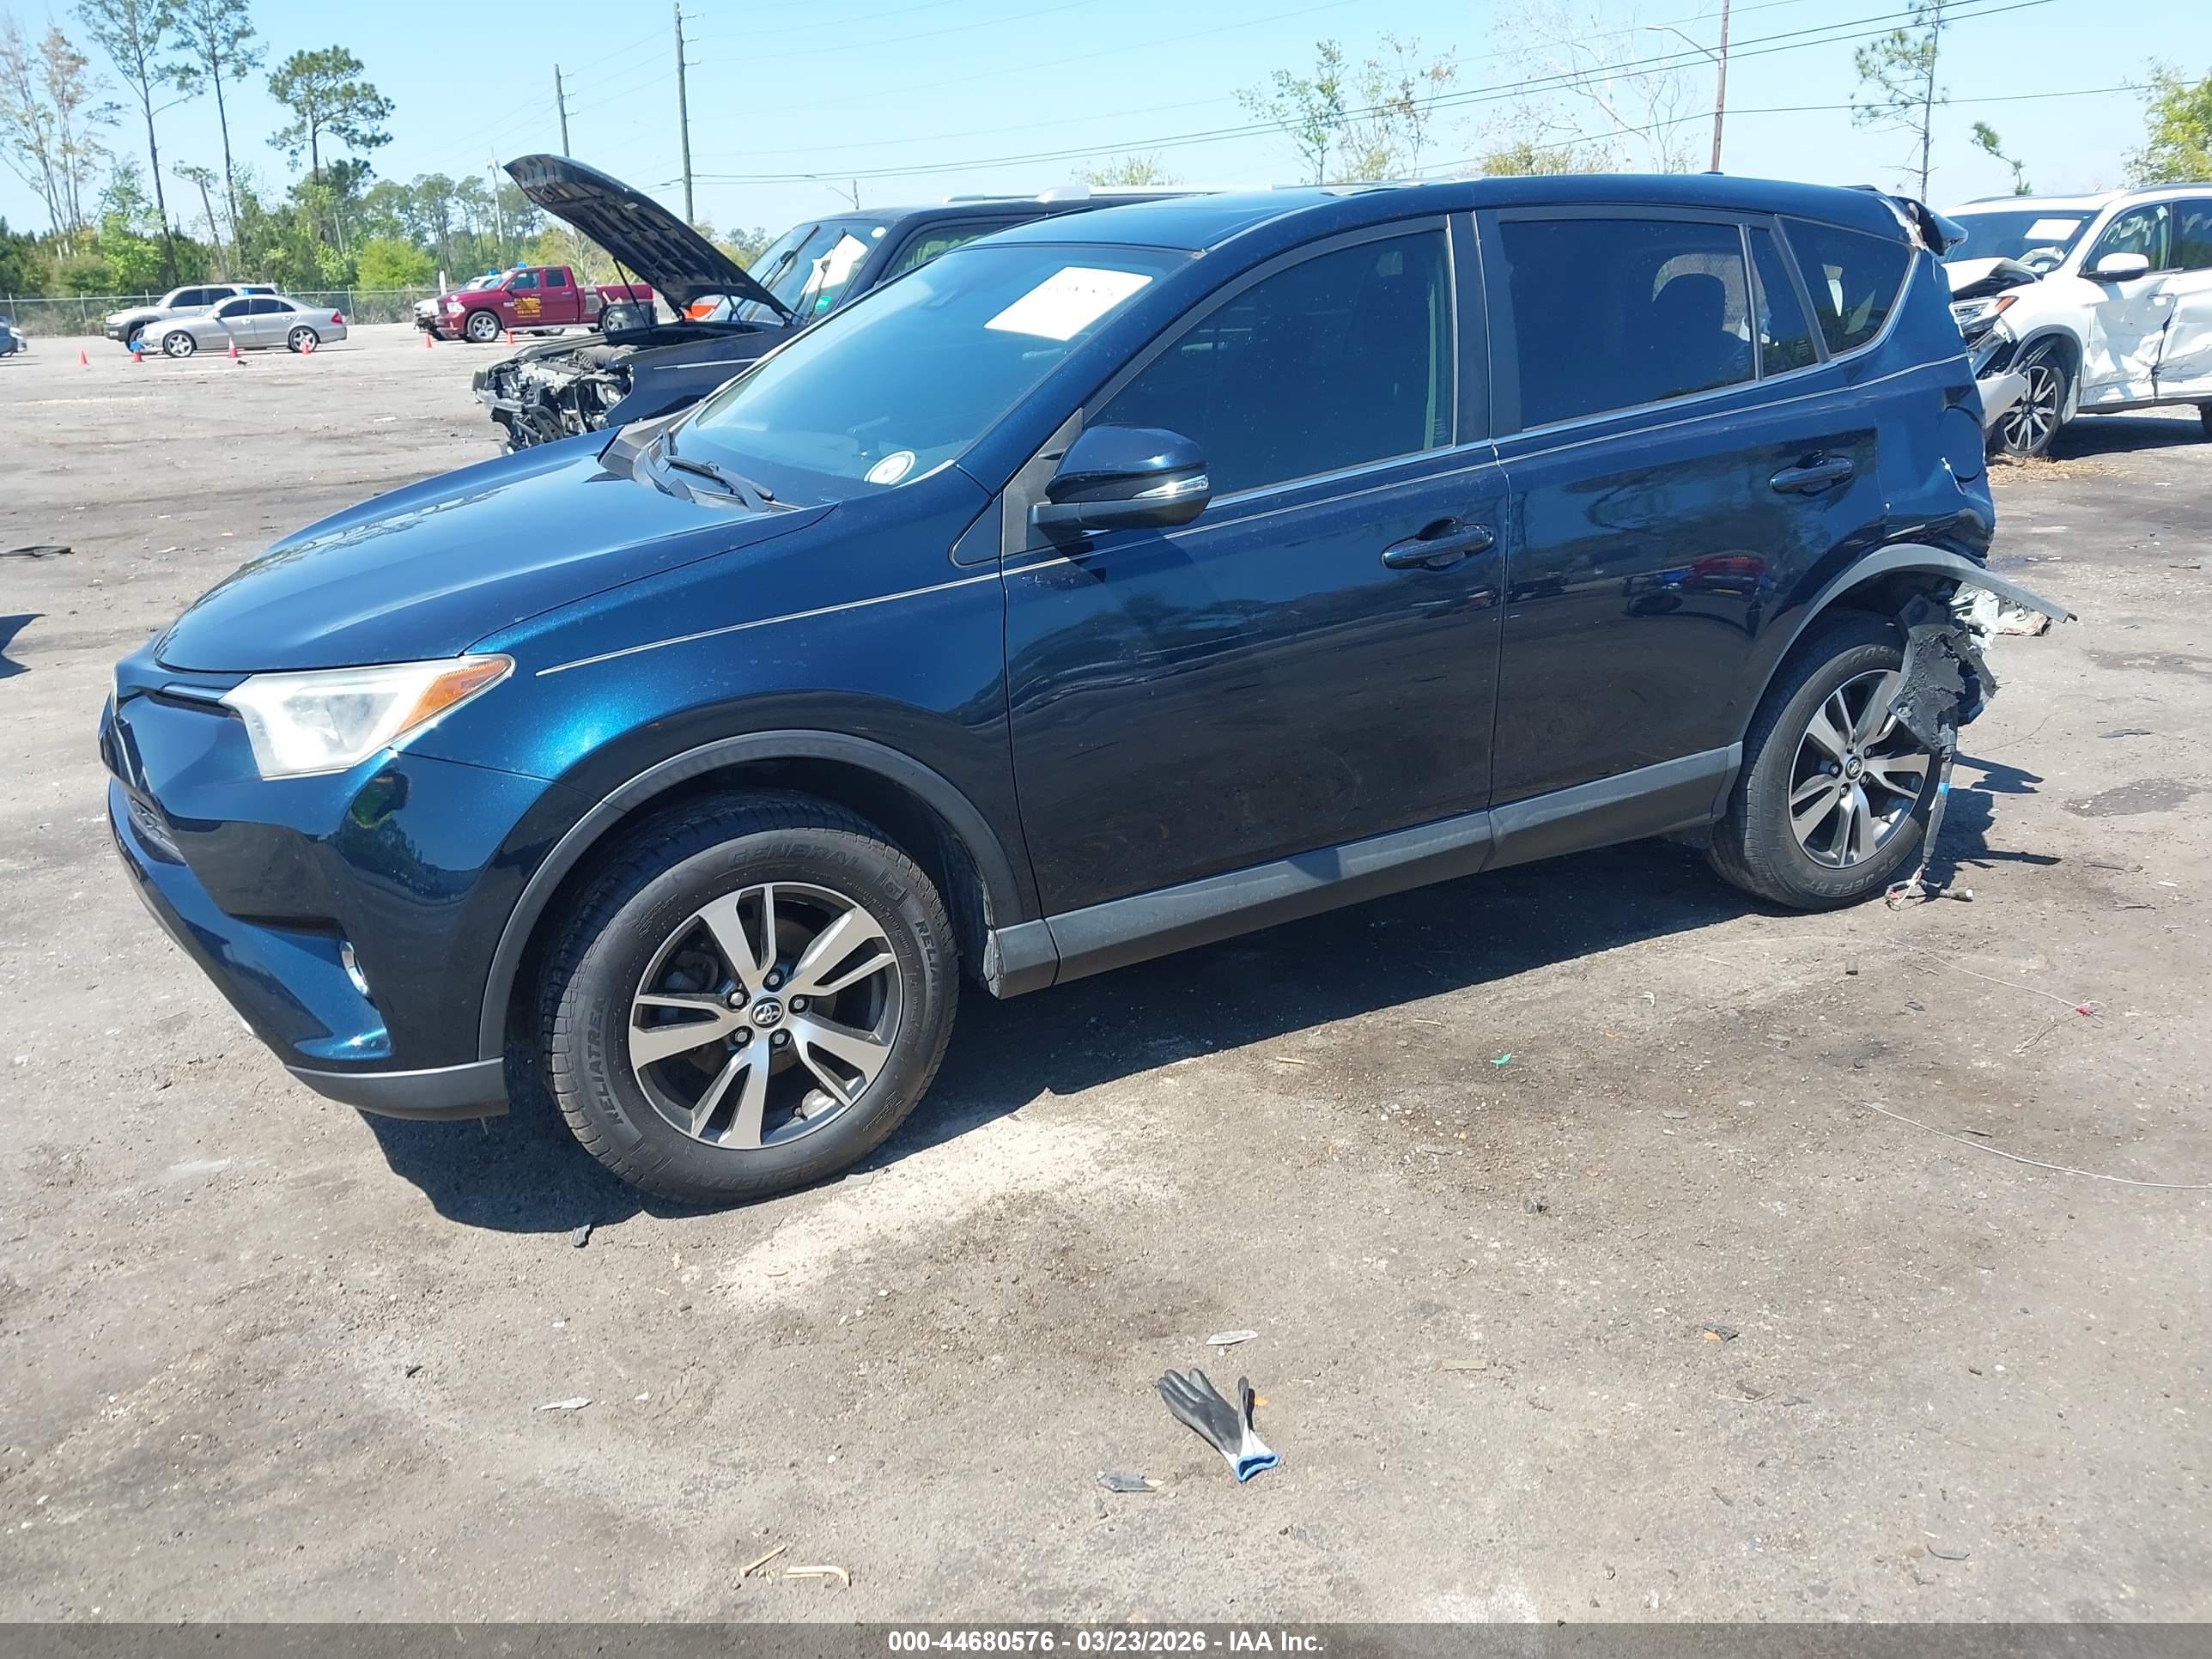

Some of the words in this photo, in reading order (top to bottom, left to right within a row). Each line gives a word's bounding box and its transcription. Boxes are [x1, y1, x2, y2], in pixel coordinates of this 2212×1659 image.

[732, 840, 864, 870] GENERAL
[1807, 878, 1829, 894] HT
[1832, 872, 1875, 895] JEFE
[914, 919, 942, 1041] RELIA
